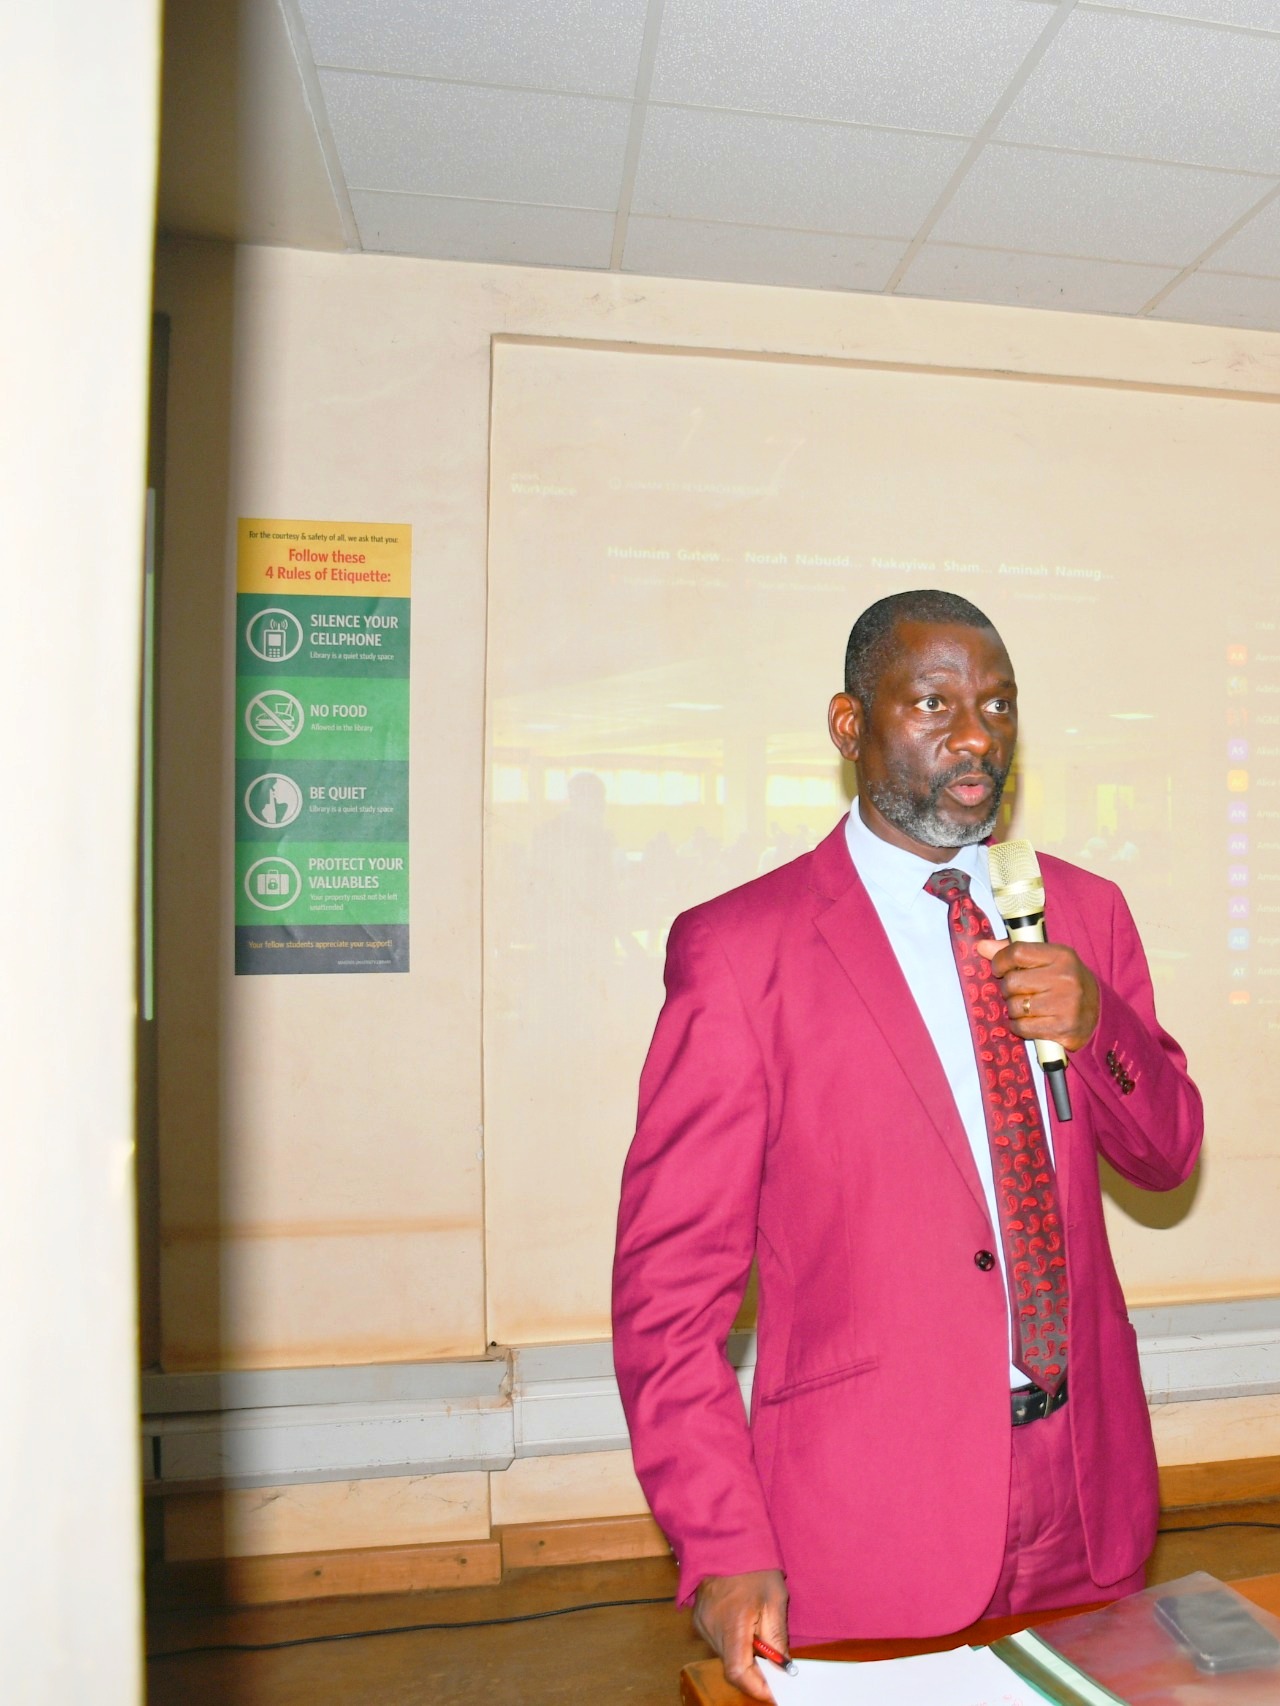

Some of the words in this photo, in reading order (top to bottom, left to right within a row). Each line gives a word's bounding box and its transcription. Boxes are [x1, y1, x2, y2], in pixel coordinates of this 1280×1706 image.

[510, 483, 578, 497] Workplace
[272, 532, 300, 541] courtesy
[308, 533, 328, 542] safety
[288, 548, 328, 562] Follow
[332, 550, 366, 564] these
[745, 551, 788, 565] Norah
[871, 557, 936, 572] Nakayiwa
[265, 566, 274, 579] 4
[278, 566, 311, 580] Rules
[314, 568, 328, 580] of
[331, 568, 392, 584] Etiquette:
[998, 562, 1048, 576] Aminah
[1055, 566, 1114, 582] Namug...
[310, 614, 360, 628] SILENCE
[364, 616, 398, 628] YOUR
[310, 632, 382, 646] CELLPHONE
[310, 652, 330, 660] Library
[343, 652, 359, 660] quiet
[360, 653, 376, 661] study
[310, 704, 329, 717] NO
[332, 704, 368, 718] FOOD
[354, 724, 373, 732] library
[310, 786, 325, 799] BE
[328, 786, 367, 801] QUIET
[310, 805, 330, 813] Library
[309, 858, 365, 870] PROTECT
[368, 858, 404, 870] YOUR
[308, 876, 380, 888] VALUABLES
[324, 894, 350, 902] property
[265, 940, 284, 948] fellow
[286, 940, 314, 948] students
[316, 940, 349, 949] appreciate
[350, 941, 364, 949] your
[366, 940, 392, 949] support!
